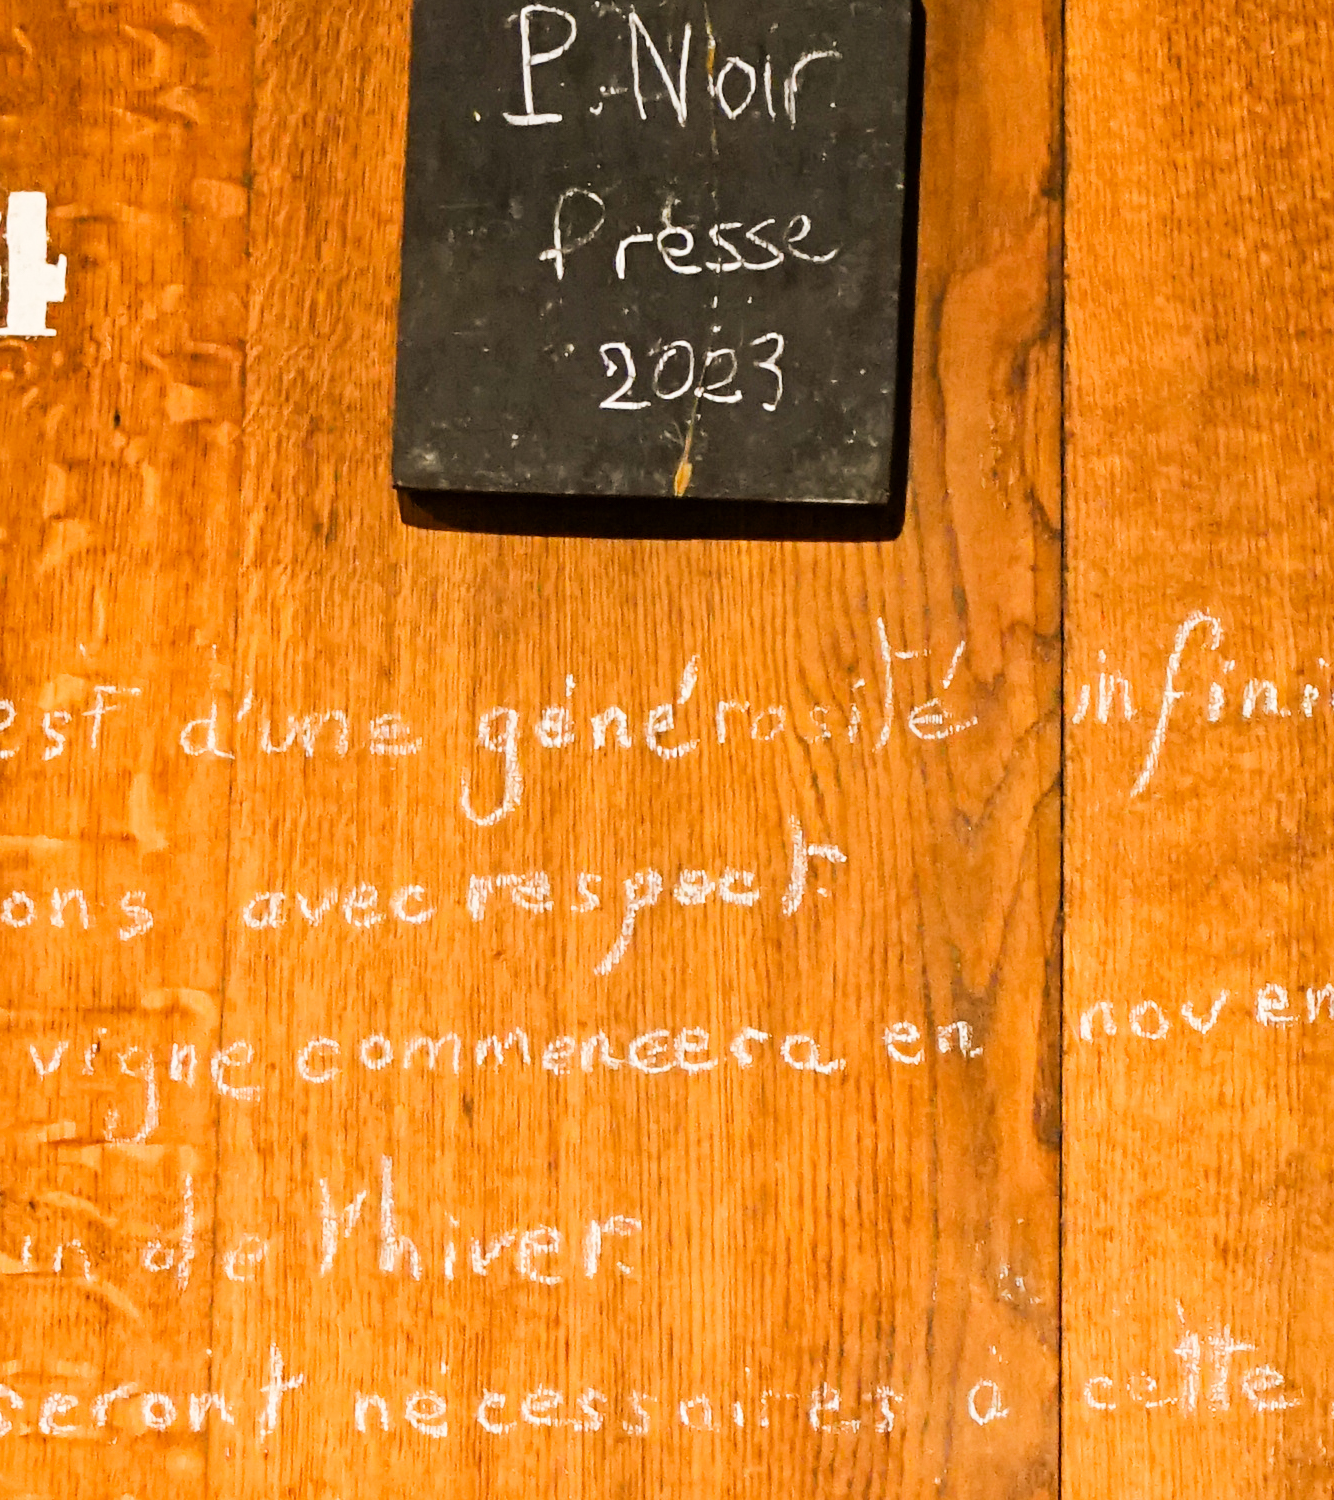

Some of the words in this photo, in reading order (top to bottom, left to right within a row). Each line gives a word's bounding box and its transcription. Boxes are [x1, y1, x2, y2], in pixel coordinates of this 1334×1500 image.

[599, 332, 785, 412] 2023
[242, 881, 435, 928] avec
[29, 1027, 260, 1142] vigne
[298, 1026, 846, 1083] commencera
[884, 1020, 984, 1066] en
[142, 1173, 268, 1290] de
